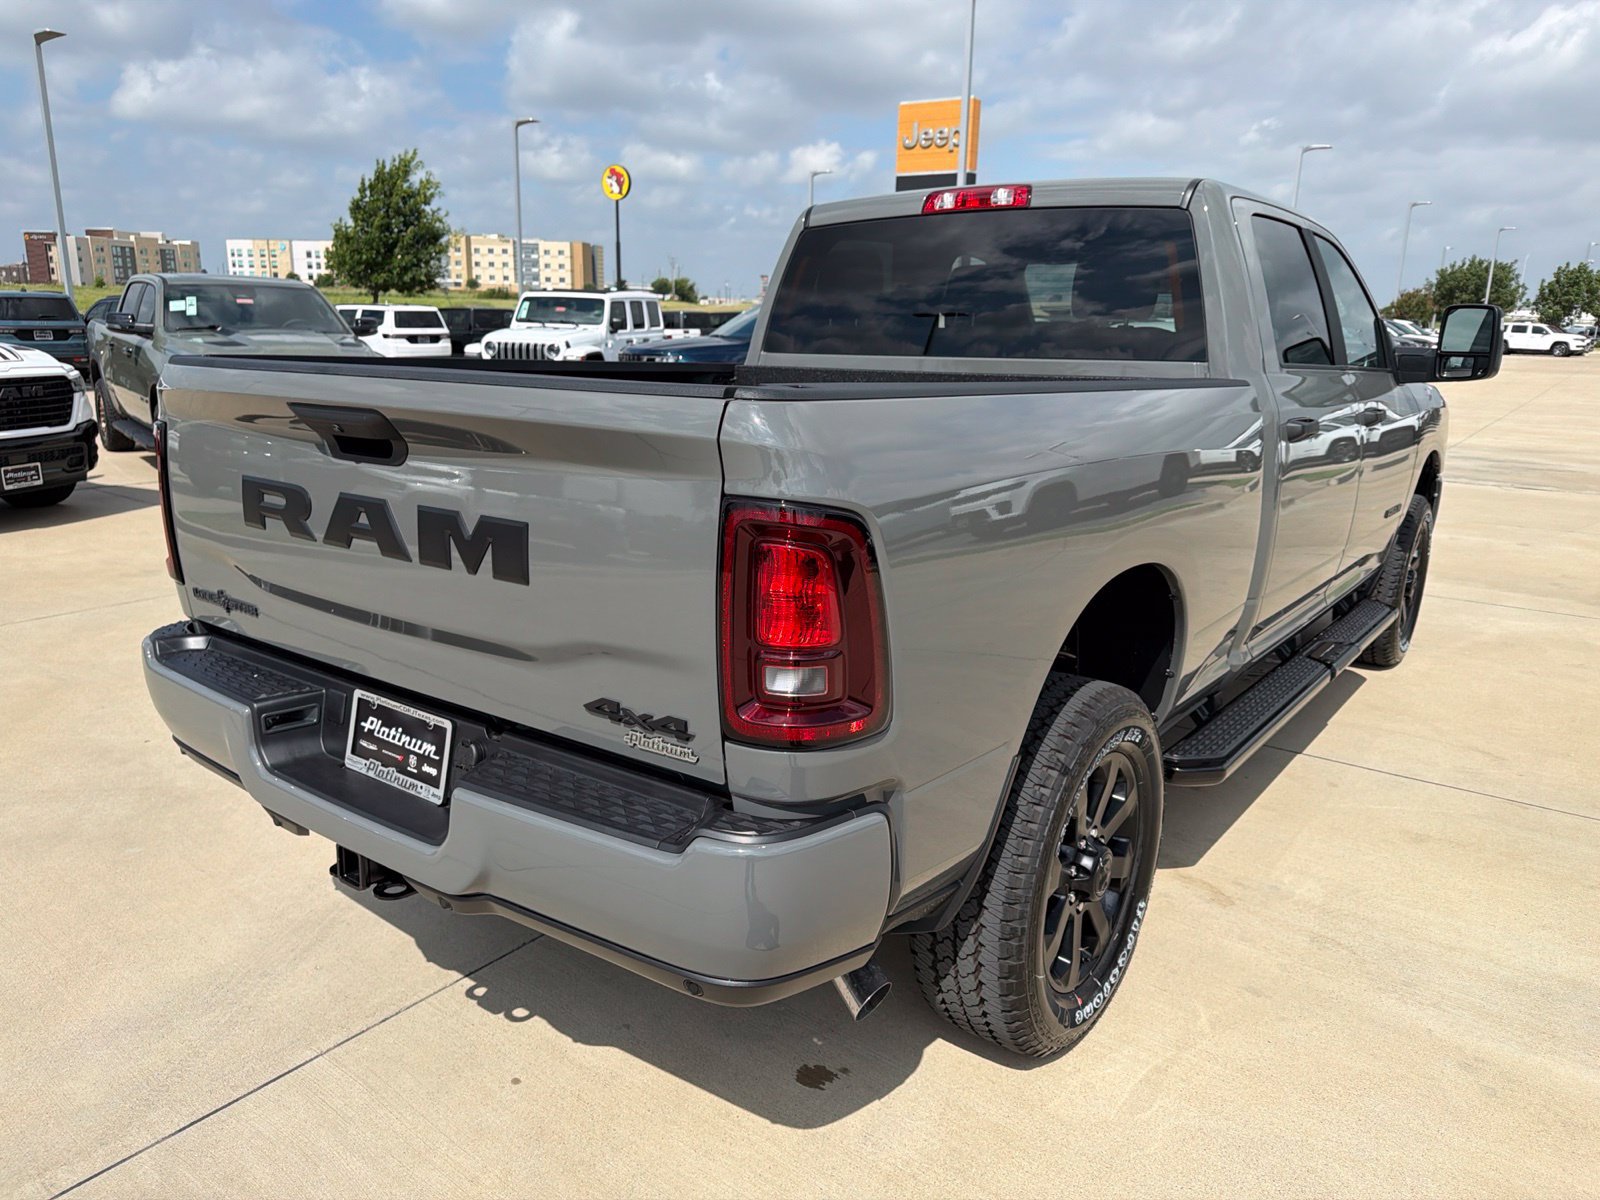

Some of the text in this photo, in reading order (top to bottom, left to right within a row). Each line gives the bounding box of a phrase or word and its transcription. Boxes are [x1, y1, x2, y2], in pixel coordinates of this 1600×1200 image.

[902, 121, 960, 153] Jeep
[0, 386, 44, 399] AM
[241, 474, 530, 586] RAM
[360, 716, 440, 760] Platinum
[624, 729, 699, 765] Platinum
[366, 760, 422, 794] Platinum
[421, 763, 437, 776] Jeep
